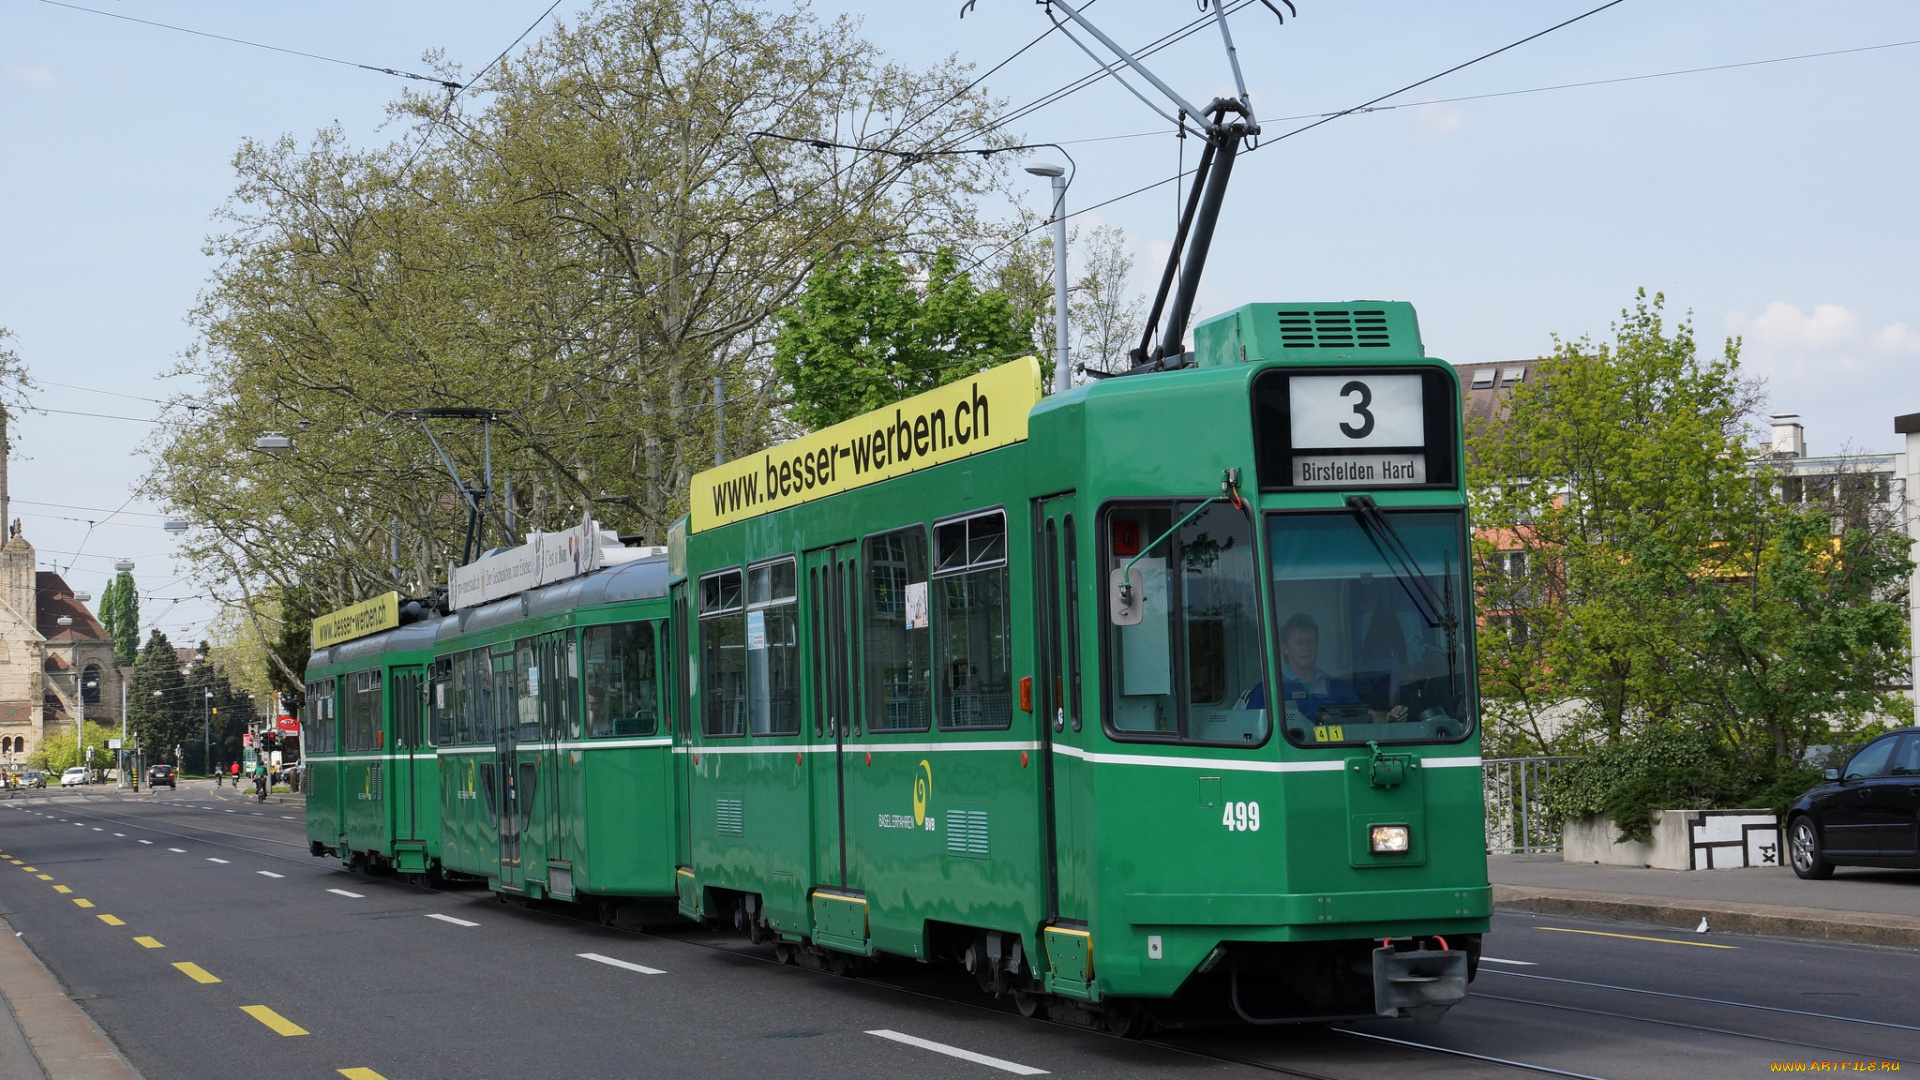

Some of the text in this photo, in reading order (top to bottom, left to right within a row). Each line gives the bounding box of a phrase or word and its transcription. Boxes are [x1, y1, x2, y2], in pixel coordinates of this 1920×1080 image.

[1339, 380, 1375, 439] 3
[712, 382, 989, 517] www.besser-werben.ch
[1302, 460, 1415, 481] Birsfelden Hard
[1319, 730, 1339, 739] 4 1
[878, 814, 915, 829] BASEL ERFAHREN
[924, 817, 936, 831] BVB
[1222, 801, 1260, 832] 499
